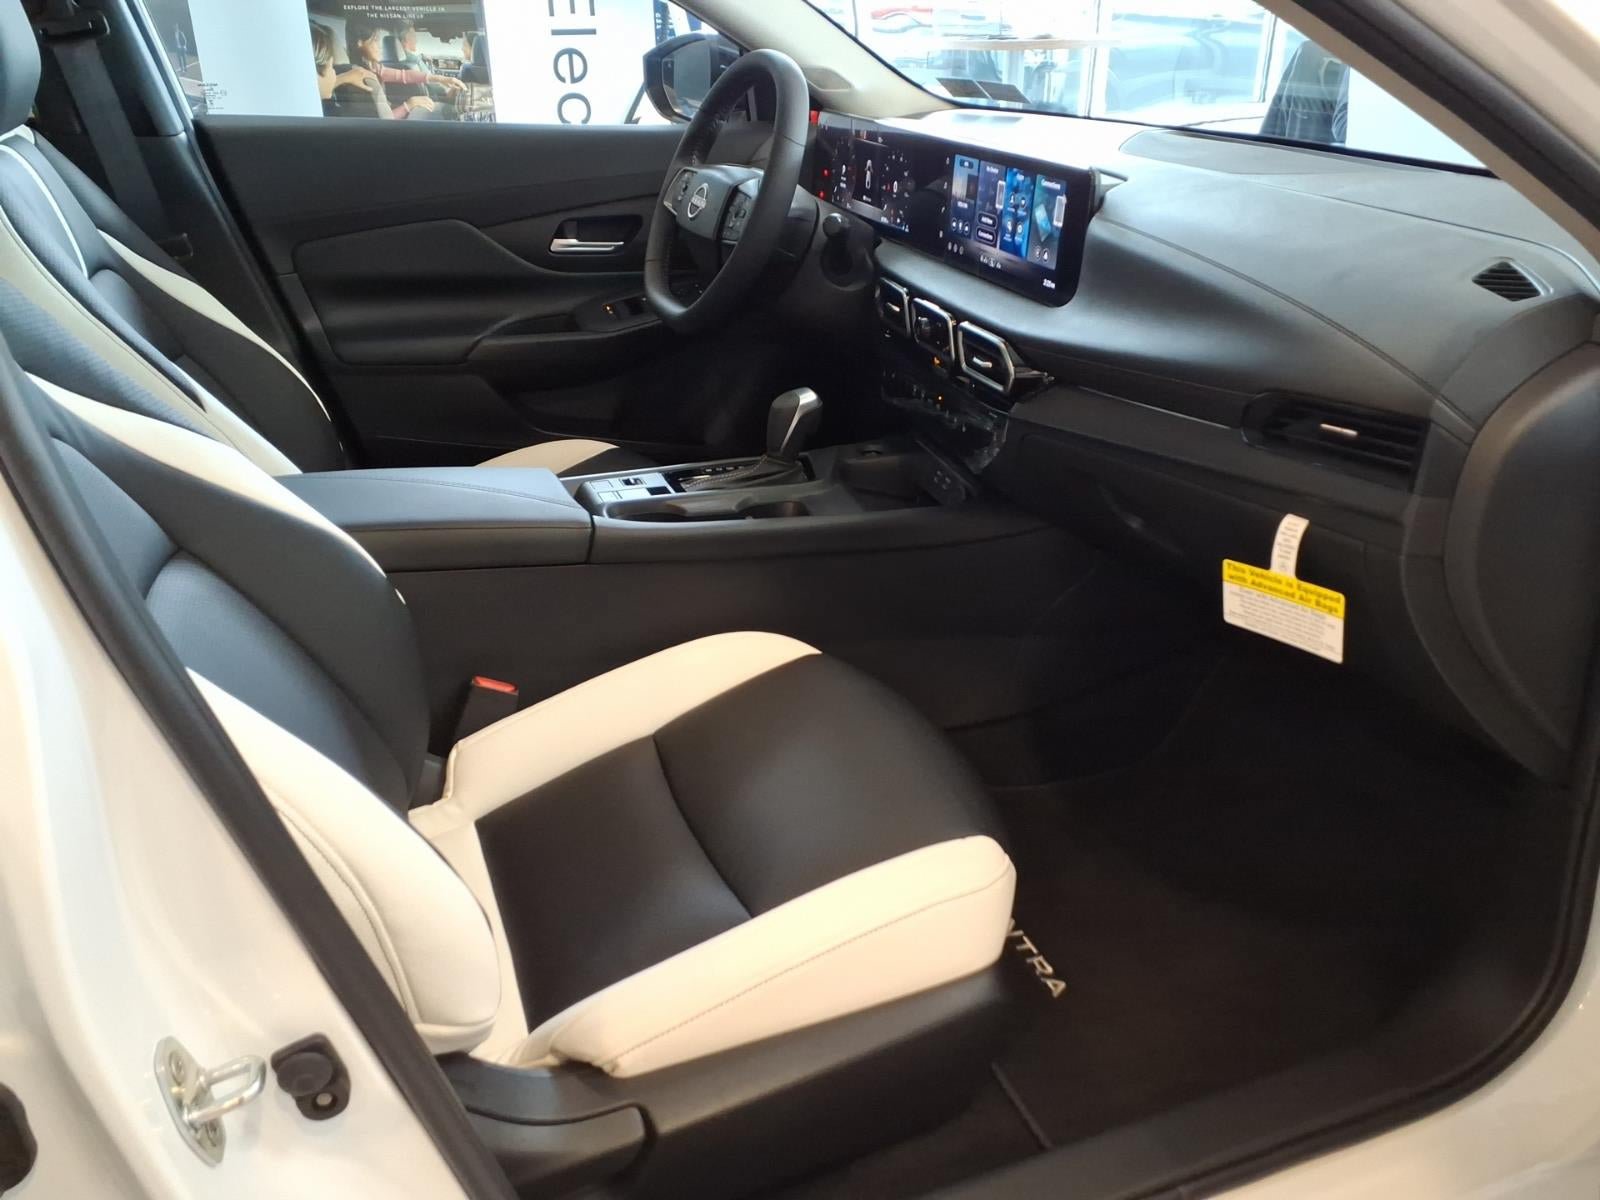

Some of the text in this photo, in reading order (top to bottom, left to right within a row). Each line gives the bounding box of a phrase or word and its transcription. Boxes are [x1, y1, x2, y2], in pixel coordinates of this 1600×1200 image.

[1226, 562, 1247, 575] This
[1249, 570, 1283, 586] Vehicle
[1297, 583, 1341, 605] Equipped
[1228, 572, 1340, 614] with Advanced Air Bags
